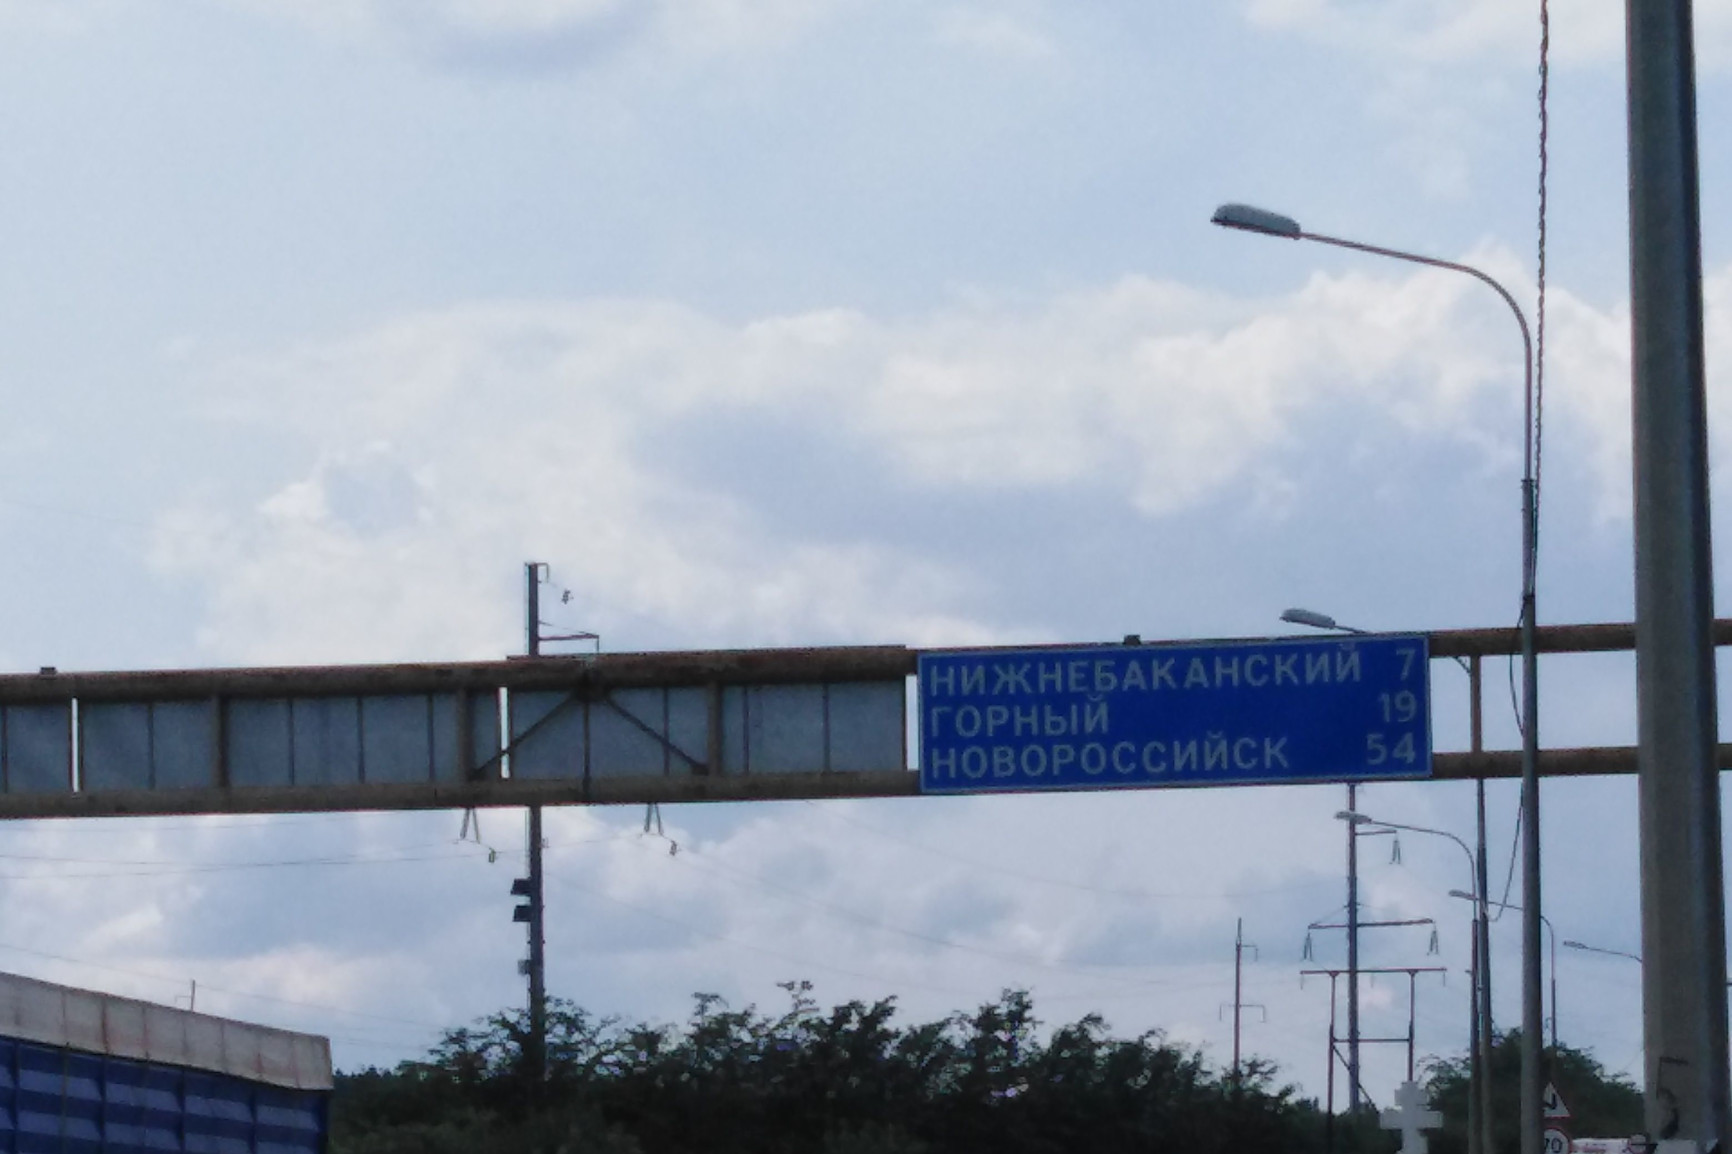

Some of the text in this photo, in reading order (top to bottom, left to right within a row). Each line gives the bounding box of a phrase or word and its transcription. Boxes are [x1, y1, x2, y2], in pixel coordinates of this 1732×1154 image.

[930, 644, 1417, 696] НИЖНЕБАКАНСКИЙ 7
[931, 691, 1417, 737] ГОРНЫЙ 19
[932, 732, 1416, 779] НОВОРОССИЙСК 54
